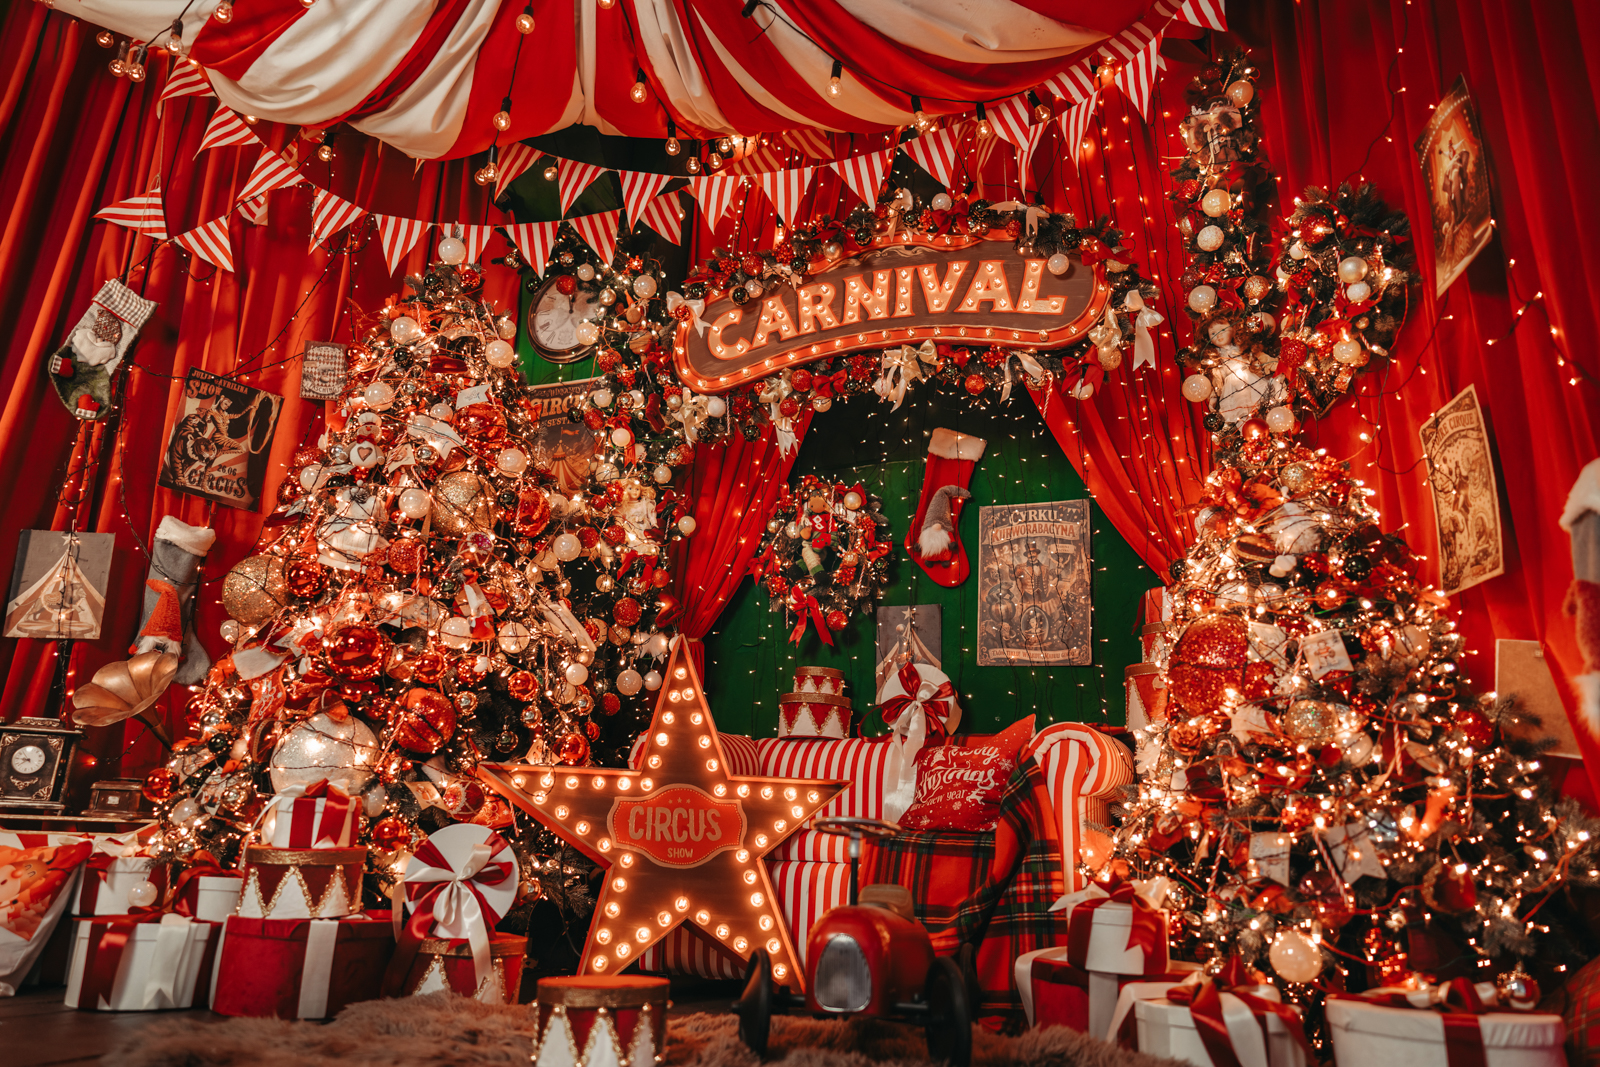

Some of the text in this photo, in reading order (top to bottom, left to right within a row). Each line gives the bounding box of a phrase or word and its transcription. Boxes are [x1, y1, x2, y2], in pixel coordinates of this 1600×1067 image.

[707, 259, 1067, 361] CARNIVAL
[186, 379, 223, 399] SHOW
[1448, 412, 1475, 430] CIRQUE
[187, 468, 248, 498] CIRCUS
[1009, 509, 1058, 526] CYRKU
[946, 790, 968, 802] year
[628, 805, 723, 843] CIRCUS
[667, 848, 694, 858] SHOW
